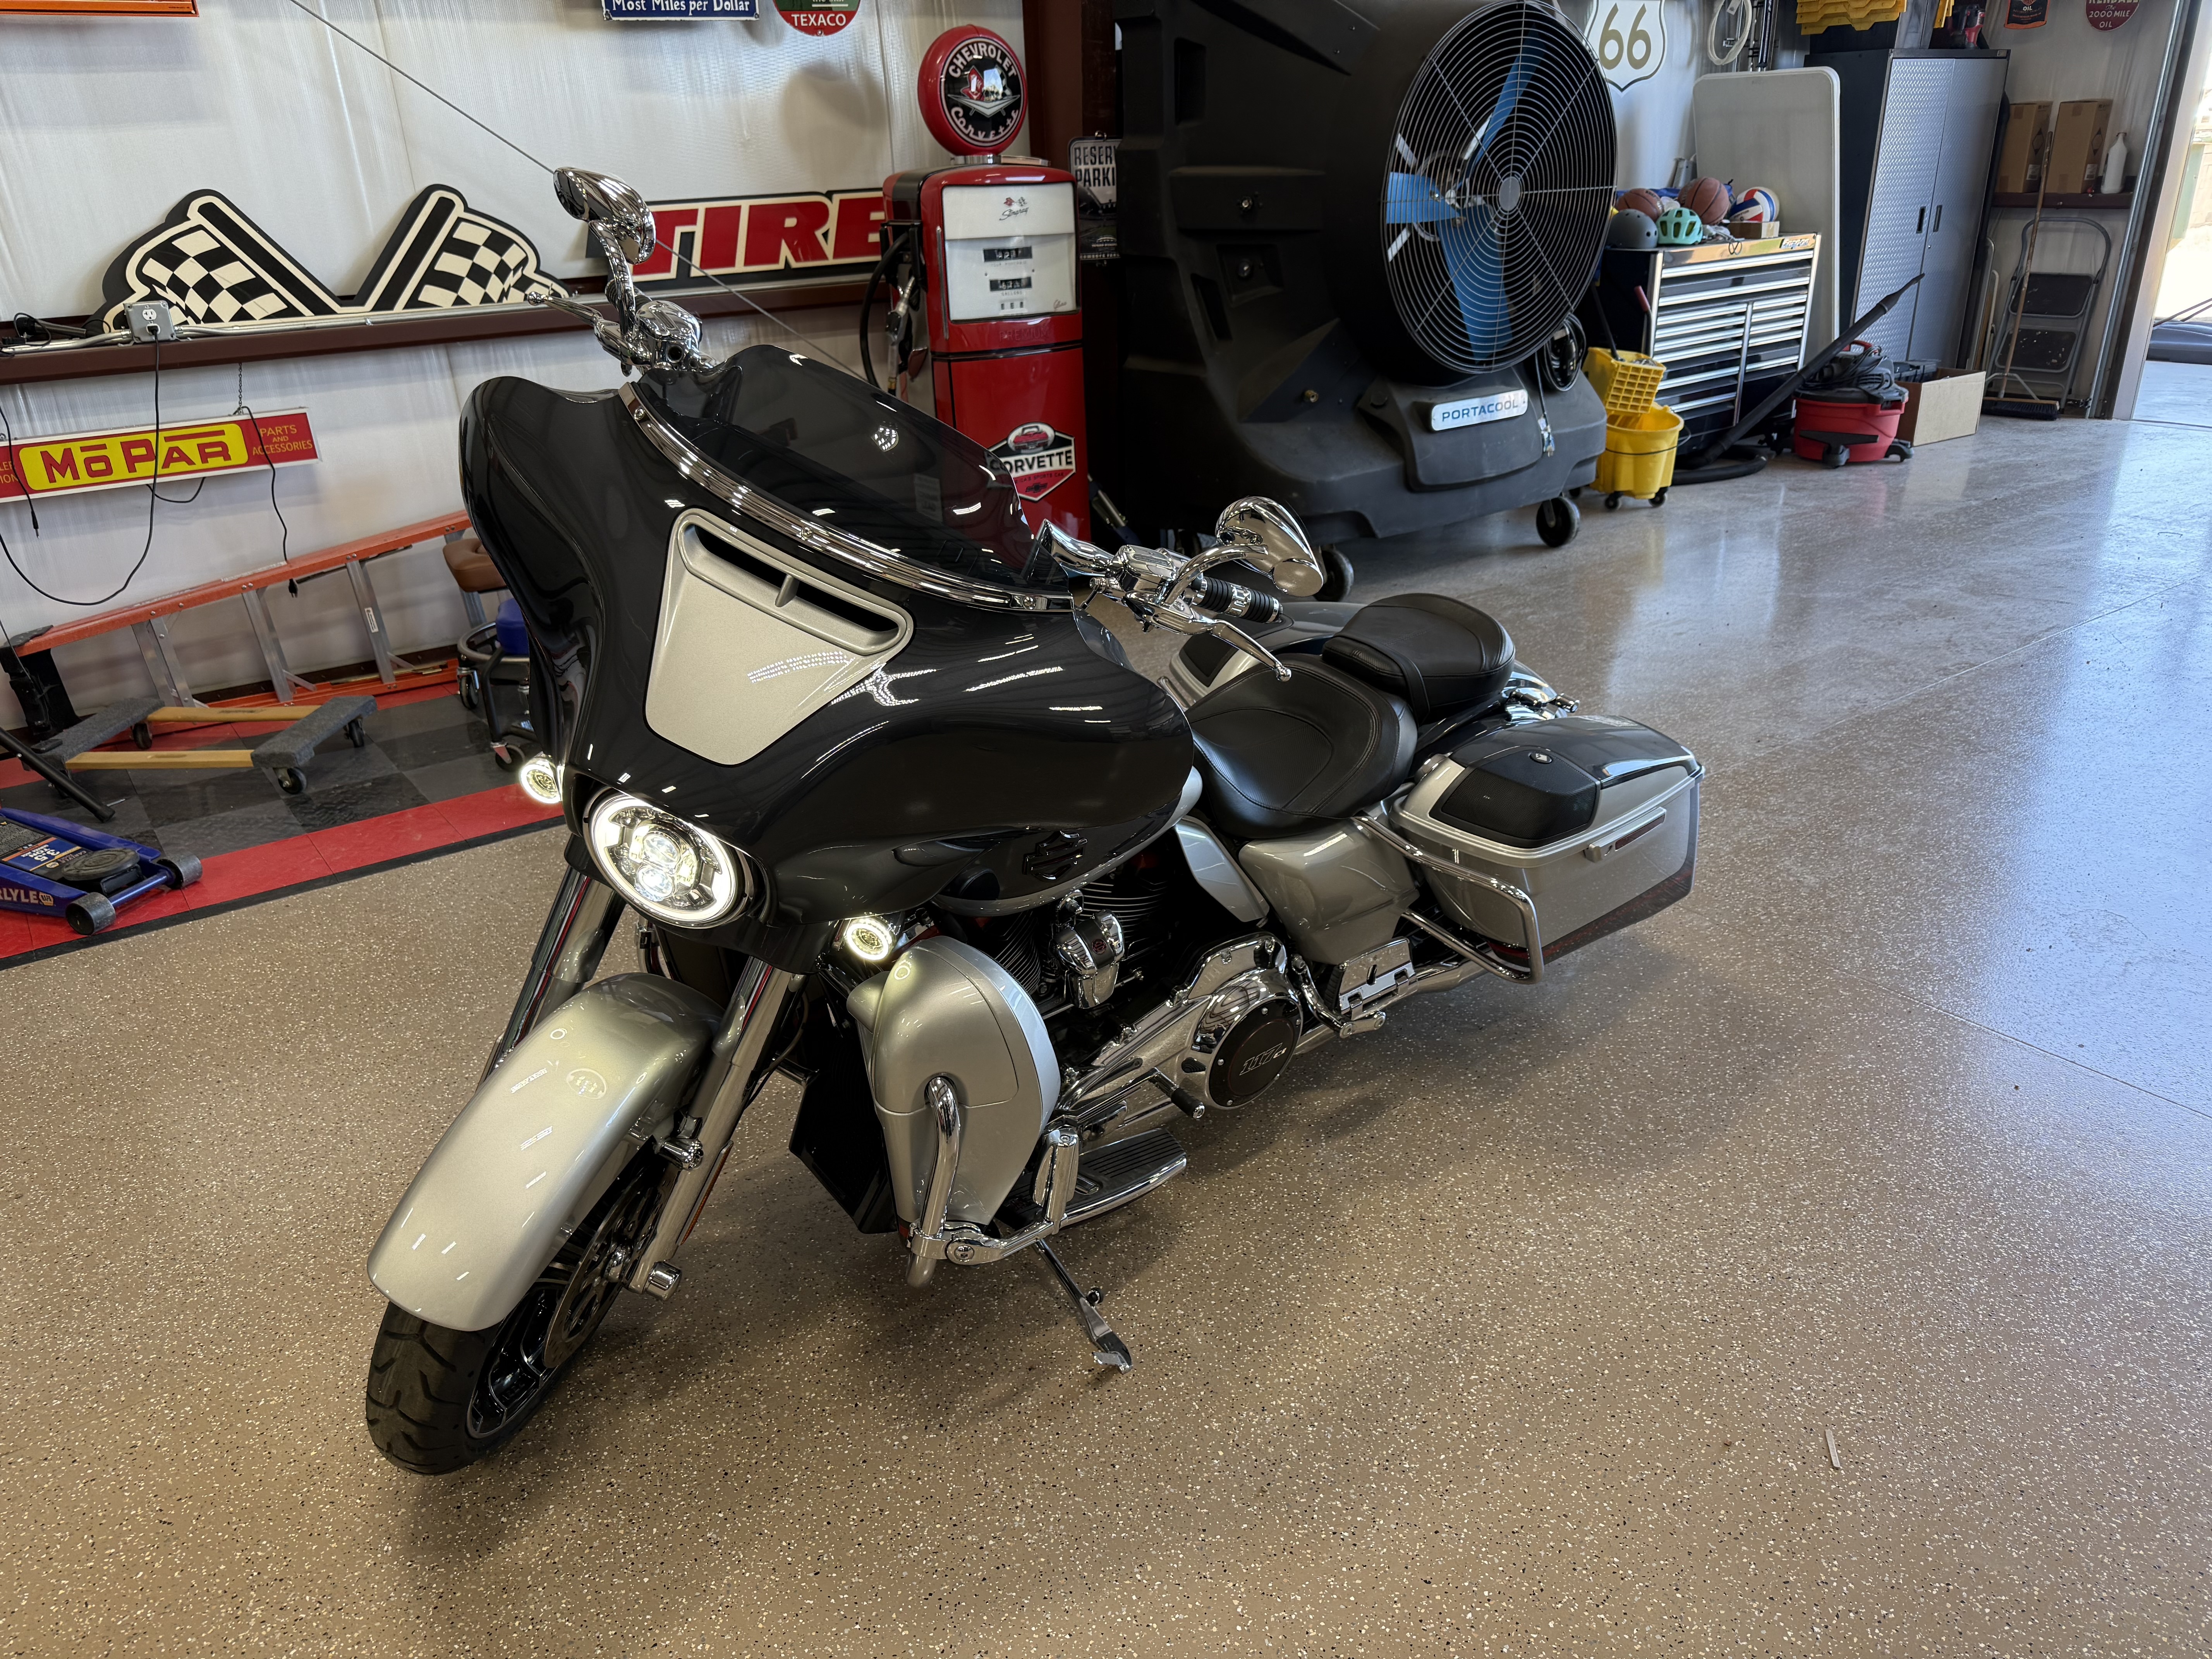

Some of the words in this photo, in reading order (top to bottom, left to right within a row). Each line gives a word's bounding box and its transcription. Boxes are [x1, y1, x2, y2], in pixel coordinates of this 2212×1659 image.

[613, 0, 646, 11] Most
[652, 0, 686, 11] Miles
[689, 1, 708, 15] per
[713, 0, 750, 11] Dollar
[791, 14, 846, 26] TEXACO
[1599, 2, 1651, 70] 66
[948, 43, 1017, 78] CHEVROLET
[1074, 145, 1116, 166] RESER
[1442, 399, 1518, 422] PORTACOOL
[259, 424, 297, 438] PARTS
[252, 440, 313, 456] ACCESSORIES
[1239, 1042, 1283, 1076] 117
